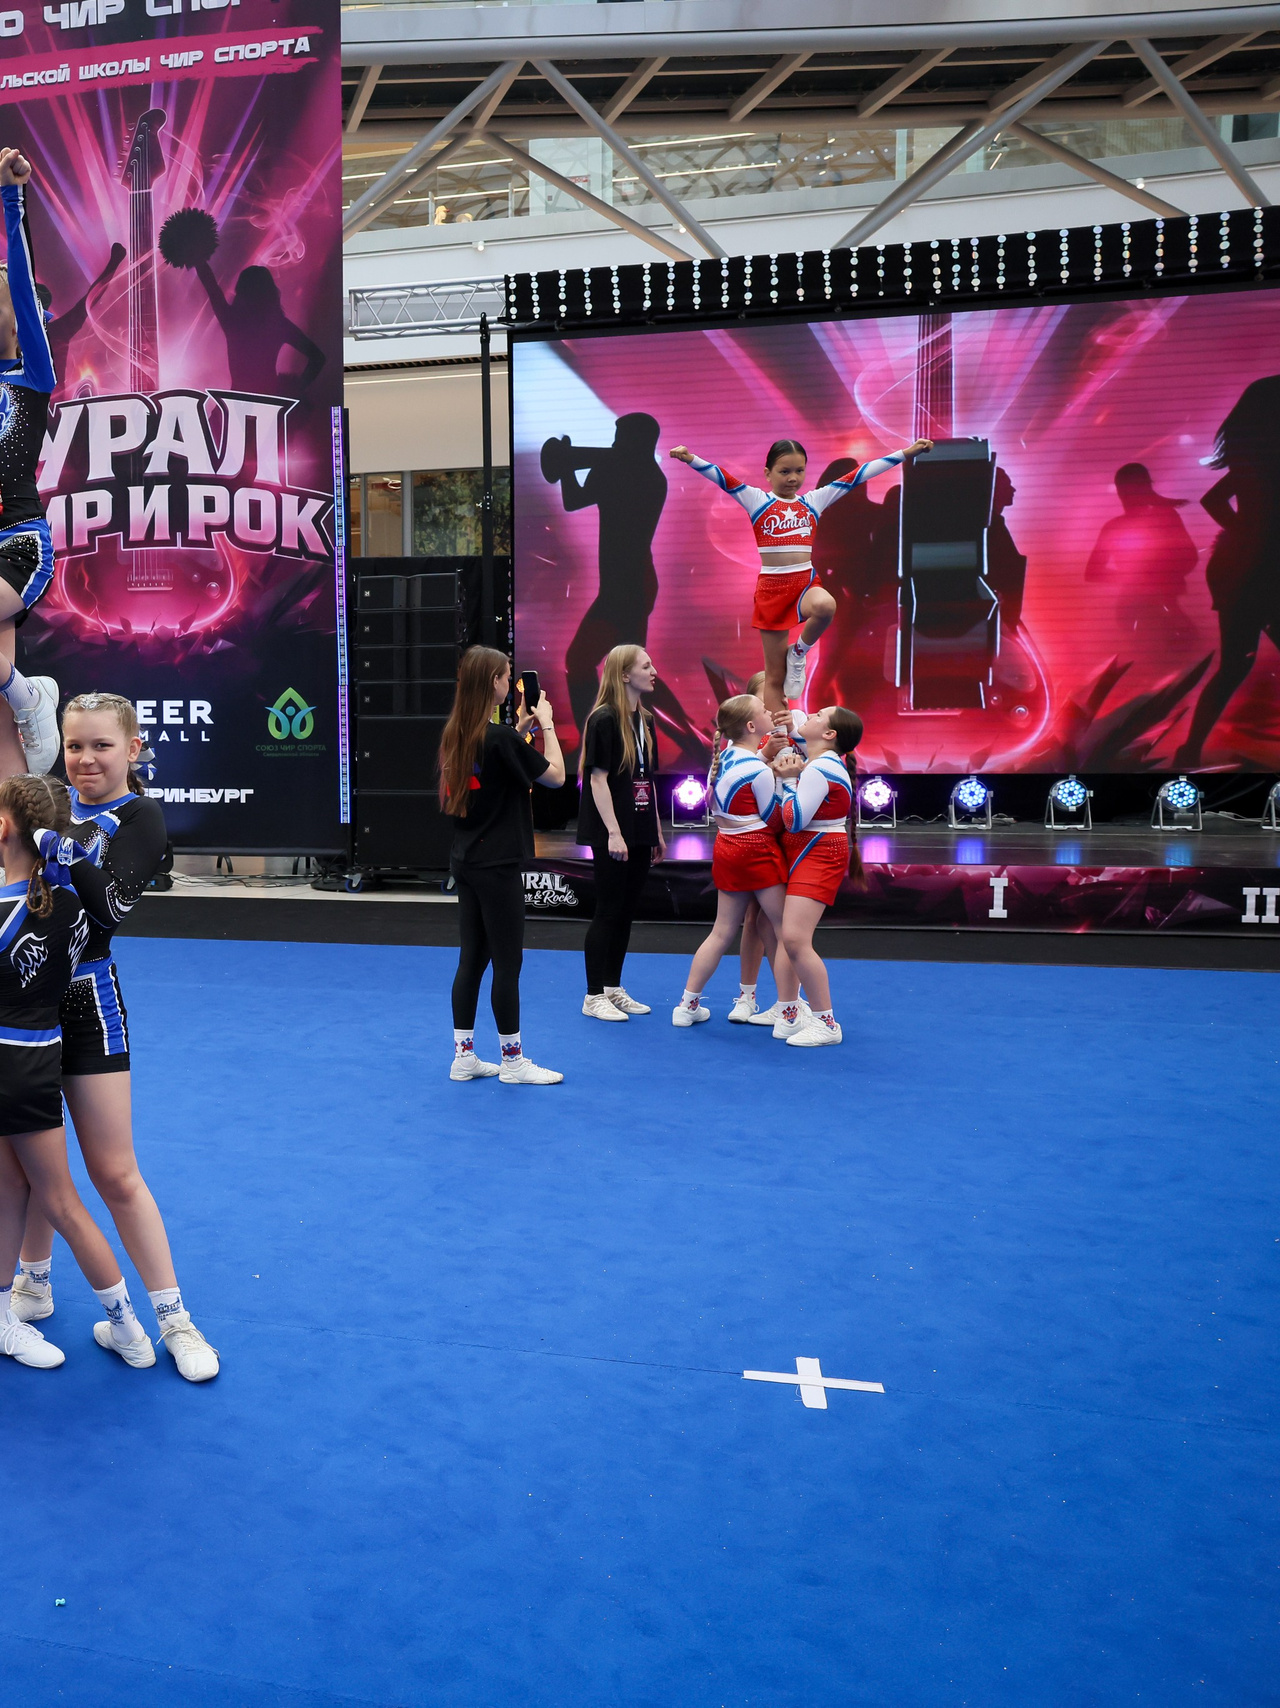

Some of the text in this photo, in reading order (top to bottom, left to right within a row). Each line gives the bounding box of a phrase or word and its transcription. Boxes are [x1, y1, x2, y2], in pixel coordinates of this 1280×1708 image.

[43, 0, 125, 30] ЧИР
[78, 57, 151, 81] ШКОЛЫ
[160, 50, 204, 68] ЧИР
[214, 36, 311, 63] СПОРТА
[128, 485, 170, 542] И
[187, 484, 330, 557] РОК
[136, 700, 215, 725] EER
[138, 730, 211, 742] MALL
[255, 744, 327, 752] СОЮЗ ЧИР СПОРТА
[144, 788, 254, 803] РИНБУРГ
[534, 890, 542, 899] &
[542, 889, 577, 904] Rock
